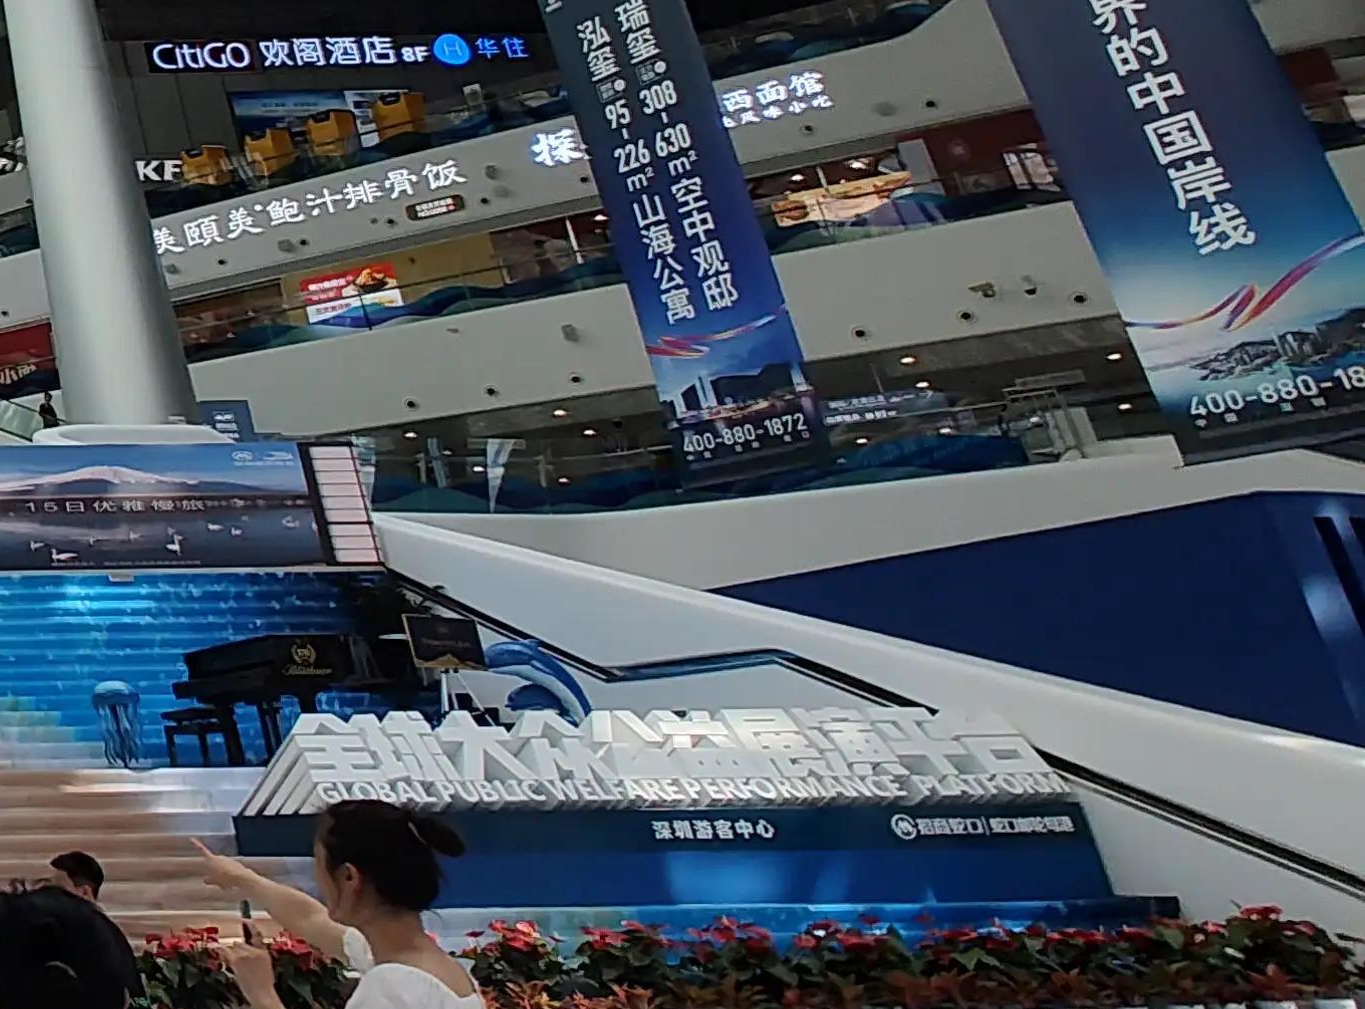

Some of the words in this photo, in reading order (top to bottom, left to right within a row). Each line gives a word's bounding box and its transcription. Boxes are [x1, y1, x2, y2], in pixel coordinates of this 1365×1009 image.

[152, 42, 251, 70] CitiGO
[259, 36, 398, 67] 欢阁酒店
[401, 46, 431, 63] 8F
[475, 37, 530, 59] 华住
[134, 159, 183, 181] KF
[682, 412, 809, 454] 400-880-1872
[316, 781, 439, 804] GLOBAL
[441, 779, 547, 804] PUBLIC
[547, 778, 683, 803] WELFARE
[686, 776, 909, 801] PERFORMANCE
[917, 773, 1071, 797] PLATFORM
[651, 819, 776, 841] 深圳游客中心
